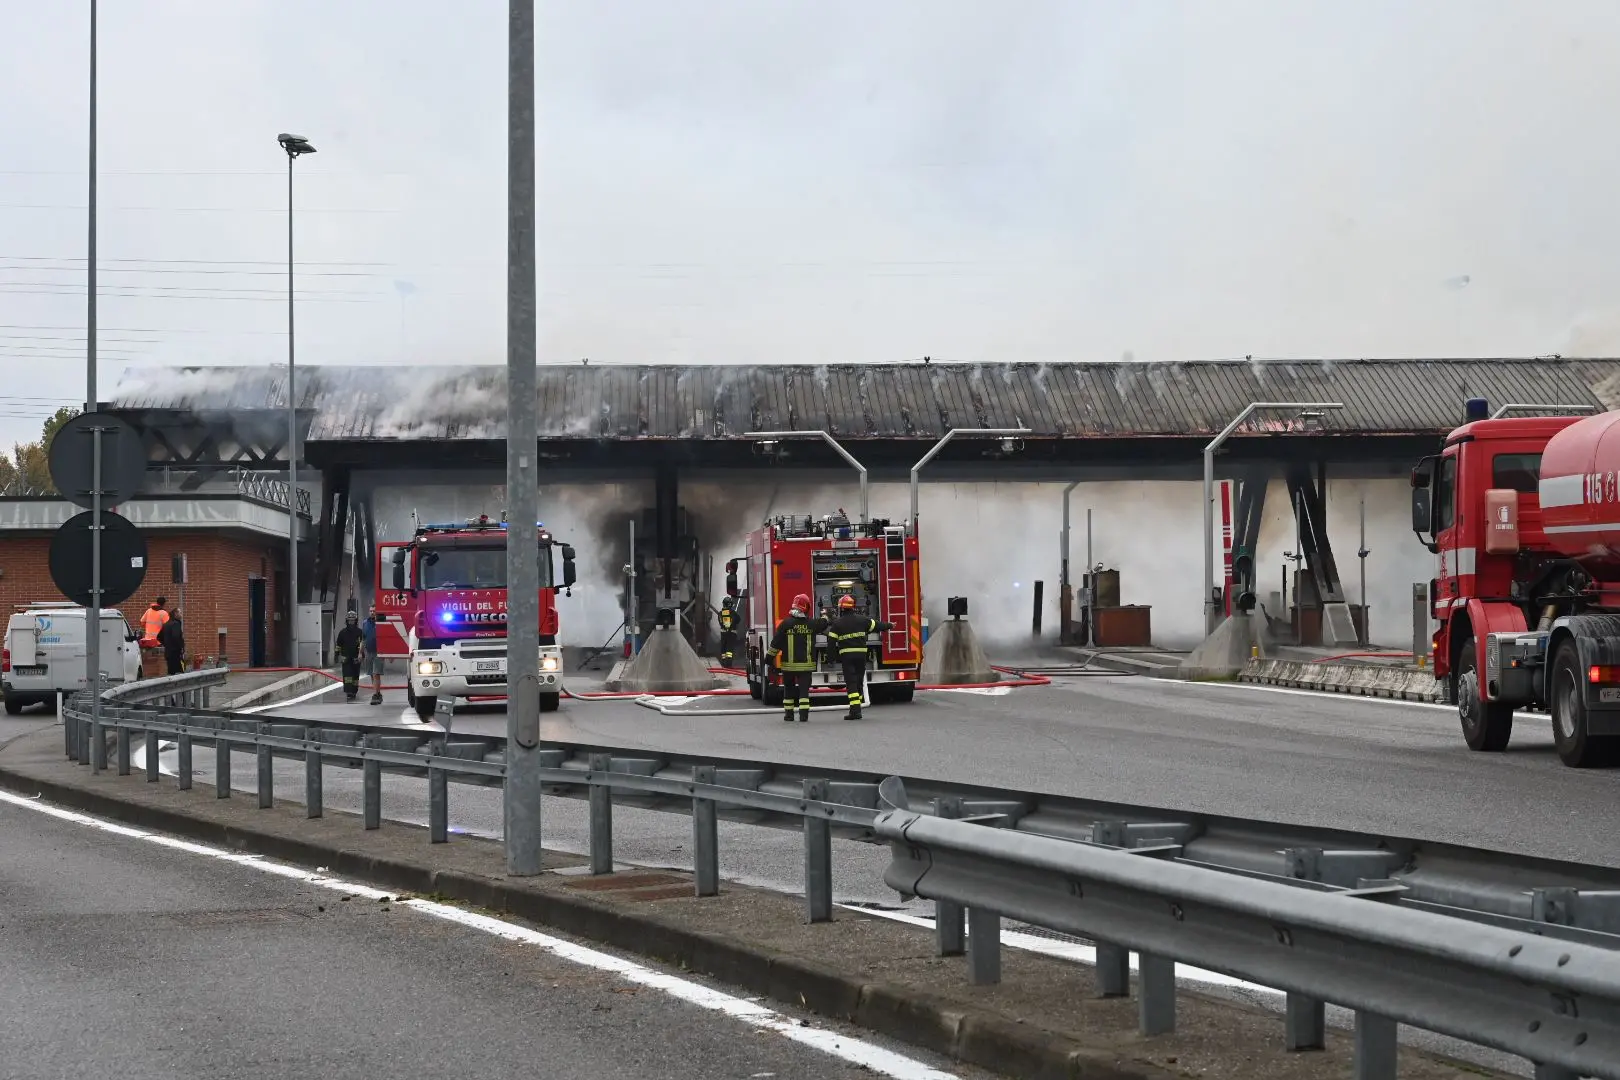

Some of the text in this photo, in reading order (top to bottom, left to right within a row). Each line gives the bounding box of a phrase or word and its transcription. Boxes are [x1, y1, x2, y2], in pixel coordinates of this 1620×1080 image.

[1586, 473, 1602, 504] 115
[391, 593, 408, 606] 115
[442, 602, 472, 611] VIGILI
[476, 602, 493, 610] DEL
[464, 612, 508, 622] IVECO
